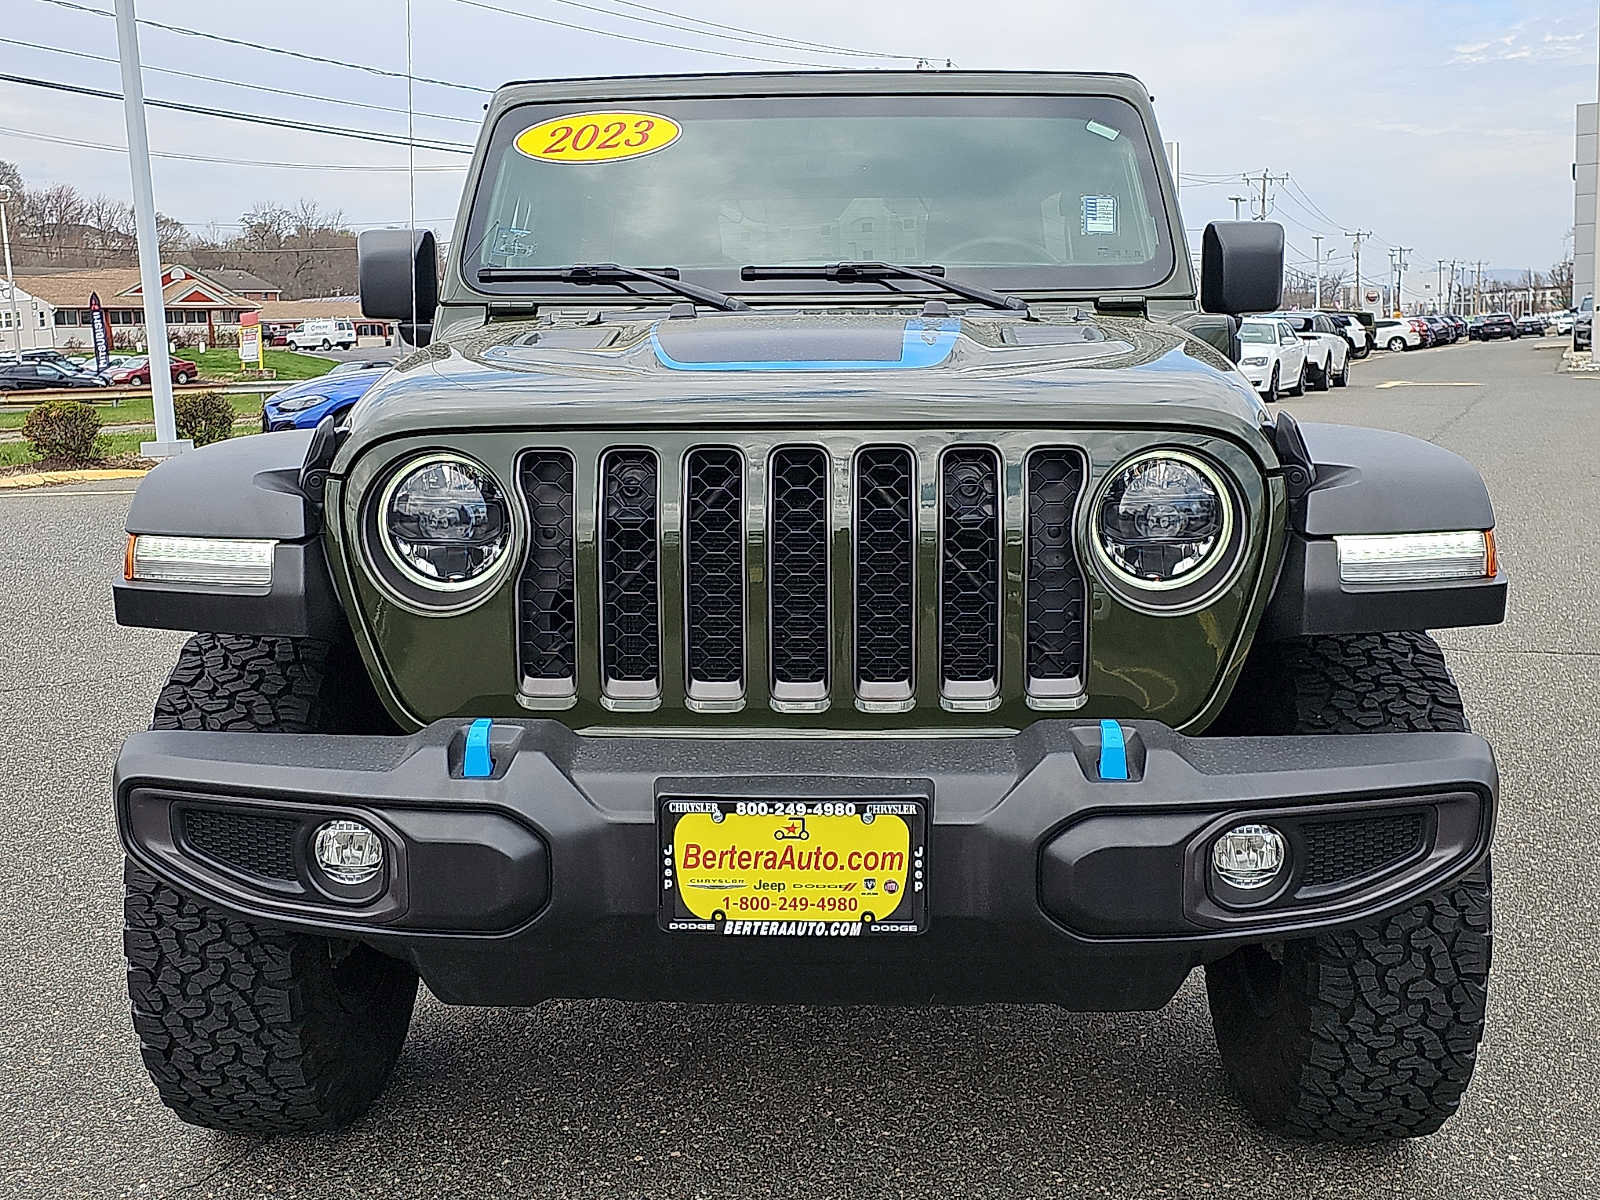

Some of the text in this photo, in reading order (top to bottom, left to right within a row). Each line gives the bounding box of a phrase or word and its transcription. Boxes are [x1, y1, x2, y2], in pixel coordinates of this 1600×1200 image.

[542, 120, 655, 154] 2023
[92, 311, 108, 369] MITSUBISHI
[668, 803, 719, 813] CHRYSLER
[736, 802, 856, 816] 800-249-4980
[866, 804, 917, 815] CHRYSLER
[683, 844, 904, 871] BerteraAuto.com
[663, 845, 673, 889] Jeep
[914, 847, 924, 892] Jeep
[753, 880, 786, 892] Jeep
[722, 897, 858, 911] 1-800-249-4980
[724, 921, 862, 936] BERTERAAUTO.COM
